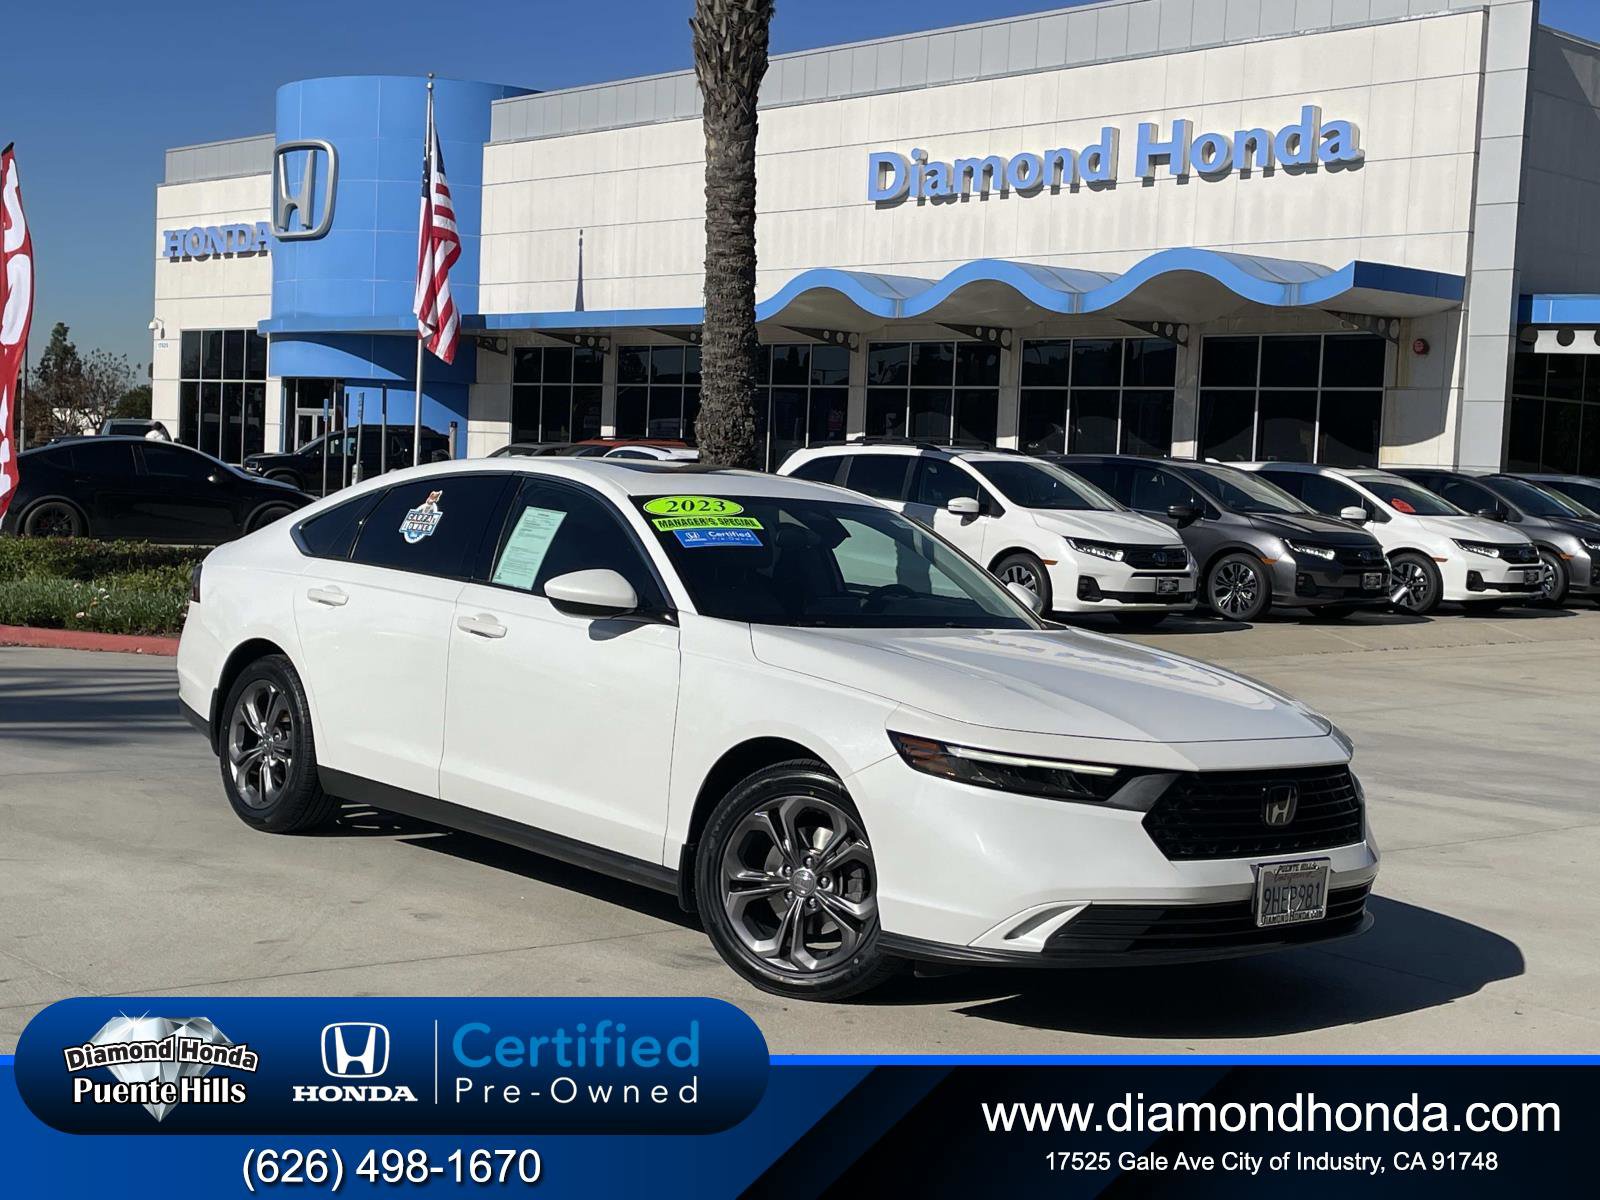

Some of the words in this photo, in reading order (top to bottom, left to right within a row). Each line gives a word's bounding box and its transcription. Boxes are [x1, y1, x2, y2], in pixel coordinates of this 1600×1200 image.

[868, 127, 1119, 201] Diamond
[1135, 105, 1361, 178] Honda
[163, 222, 271, 257] HONDA
[665, 500, 726, 512] 2023
[659, 517, 716, 529] MANAGER'S
[717, 517, 759, 528] SPECIAL
[708, 530, 752, 538] Certified
[1264, 882, 1321, 915] 9HEP981
